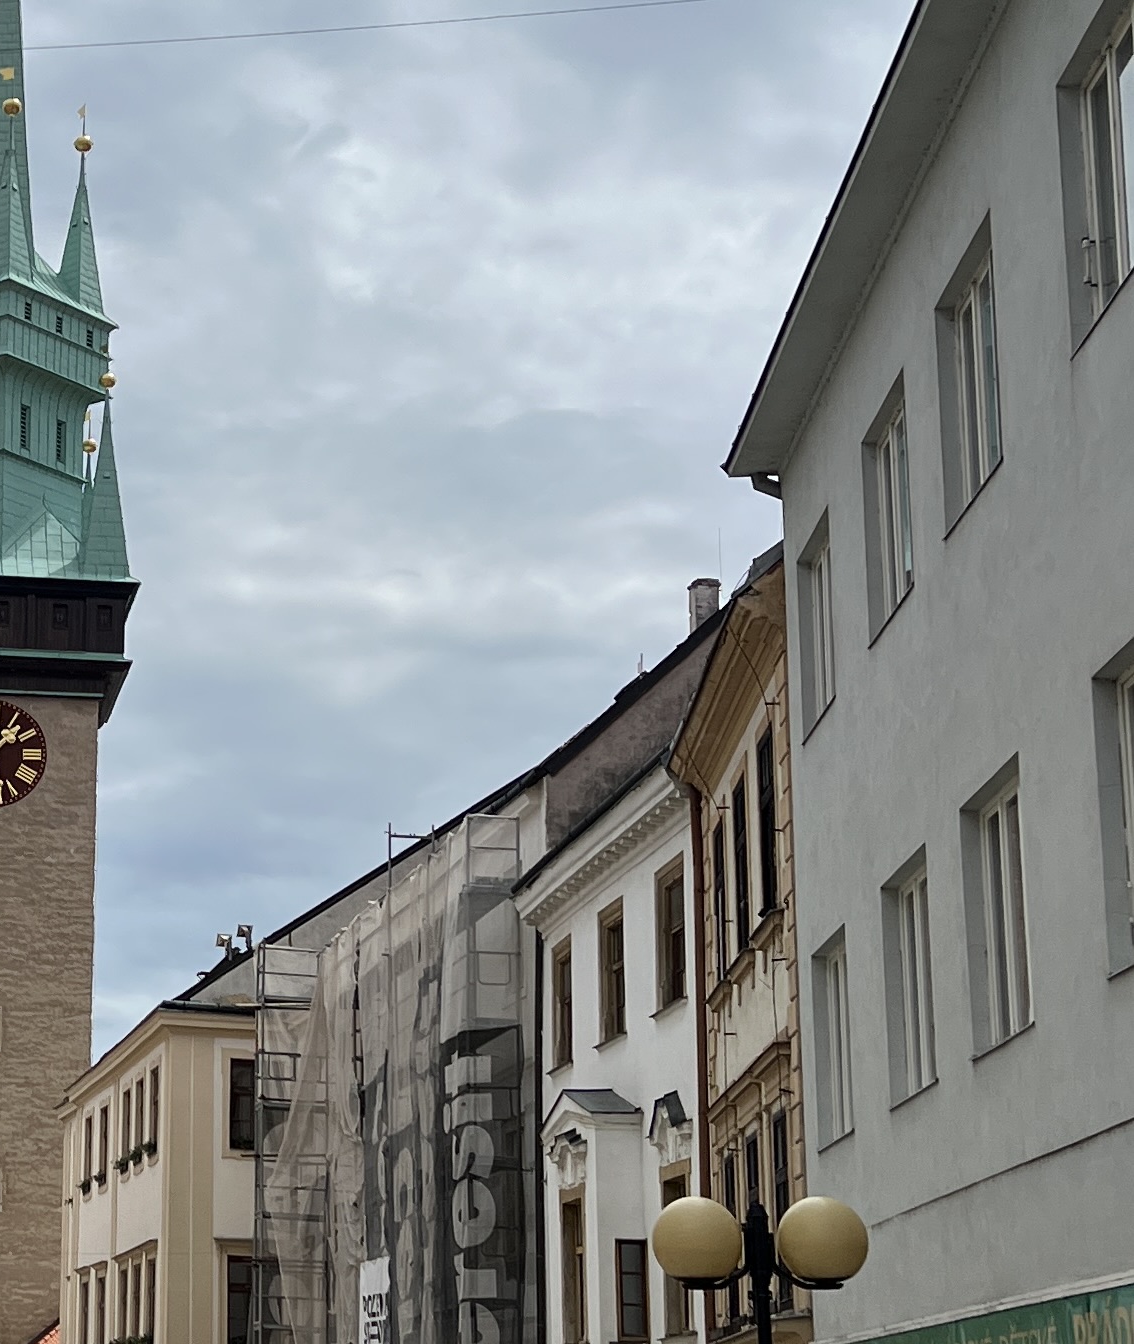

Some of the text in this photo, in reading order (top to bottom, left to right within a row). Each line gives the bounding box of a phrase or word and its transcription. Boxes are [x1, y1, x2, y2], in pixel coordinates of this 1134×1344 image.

[18, 728, 37, 742] II
[22, 748, 42, 761] III
[5, 779, 18, 798] V
